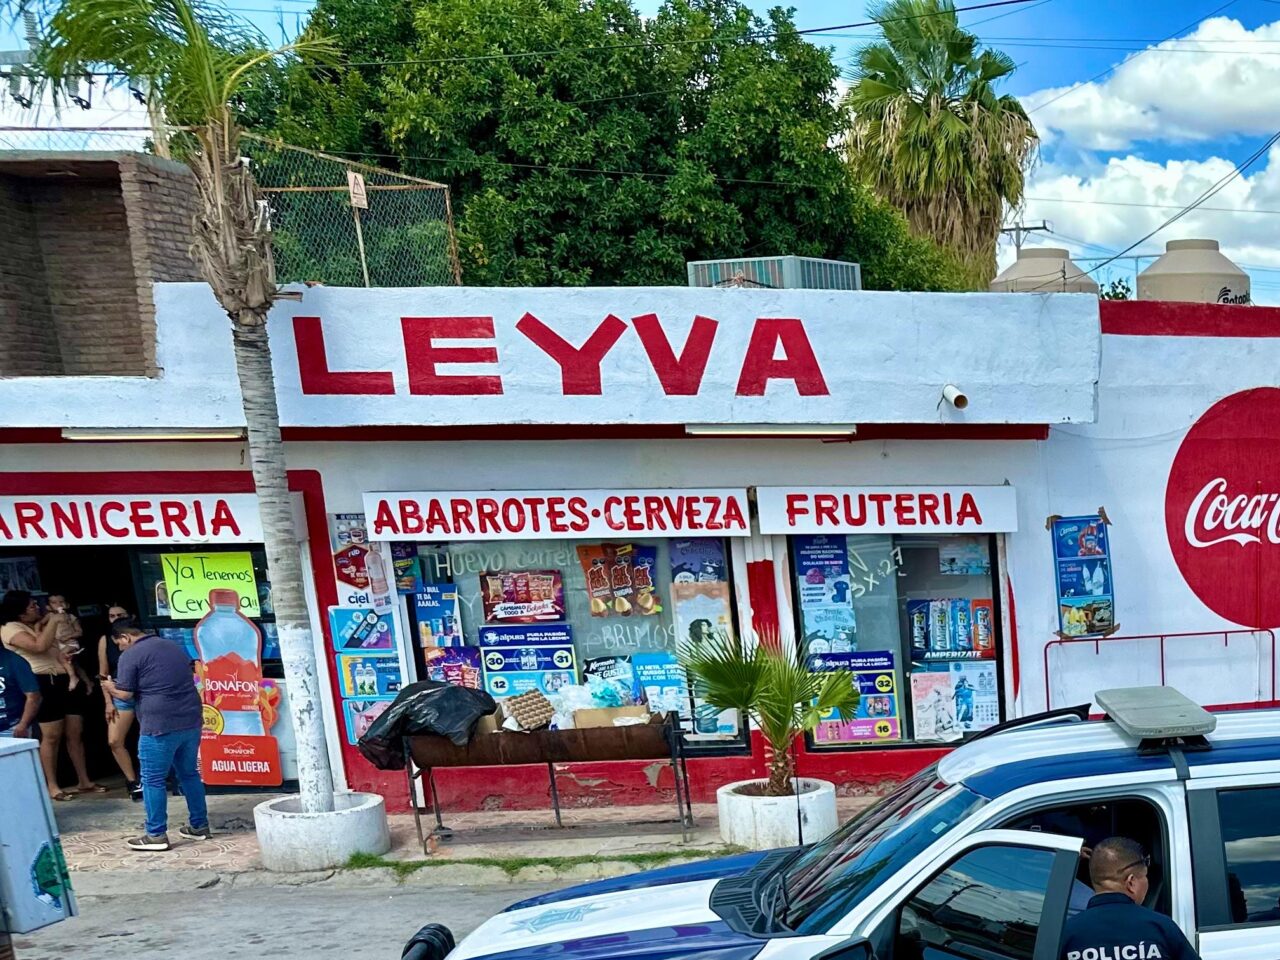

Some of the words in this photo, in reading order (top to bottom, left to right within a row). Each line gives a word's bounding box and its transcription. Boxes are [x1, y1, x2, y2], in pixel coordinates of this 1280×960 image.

[294, 313, 828, 395] LEYVA
[374, 497, 590, 534] ABARROTES
[603, 496, 746, 531] CERVEZA
[786, 493, 982, 527] FRUTERIA
[165, 556, 194, 585] Ya
[194, 556, 253, 582] Tenemos
[348, 592, 370, 604] ciel
[500, 634, 525, 642] alpura
[212, 760, 236, 771] AGUA
[238, 761, 270, 772] LIGERA
